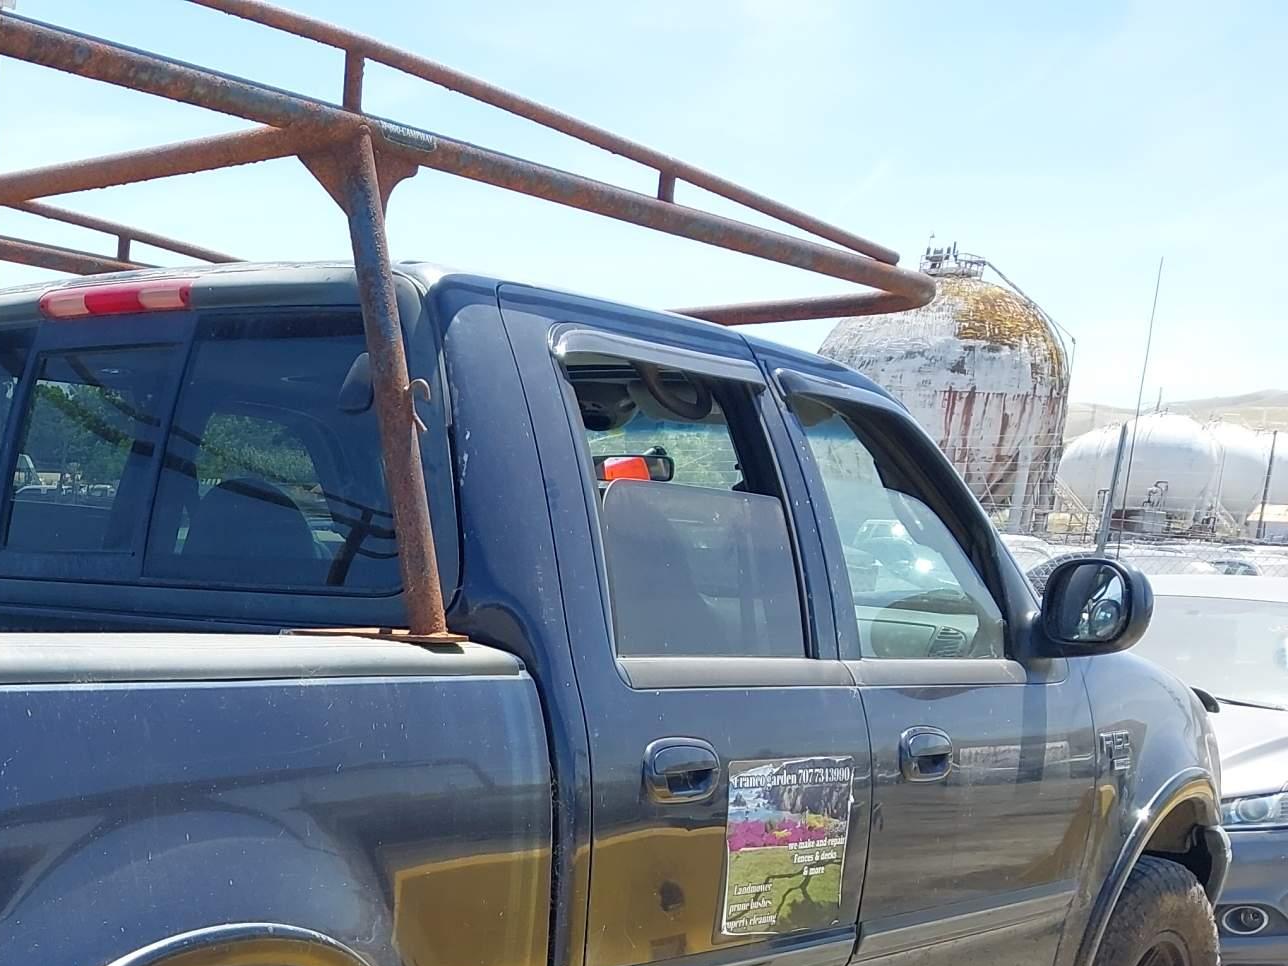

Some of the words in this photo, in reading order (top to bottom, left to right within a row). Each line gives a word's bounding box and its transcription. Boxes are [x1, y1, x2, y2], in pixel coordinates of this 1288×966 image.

[766, 769, 797, 790] garden
[798, 838, 815, 849] make
[815, 836, 827, 847] and
[827, 834, 845, 848] repair
[820, 849, 837, 860] decks
[808, 866, 825, 876] more
